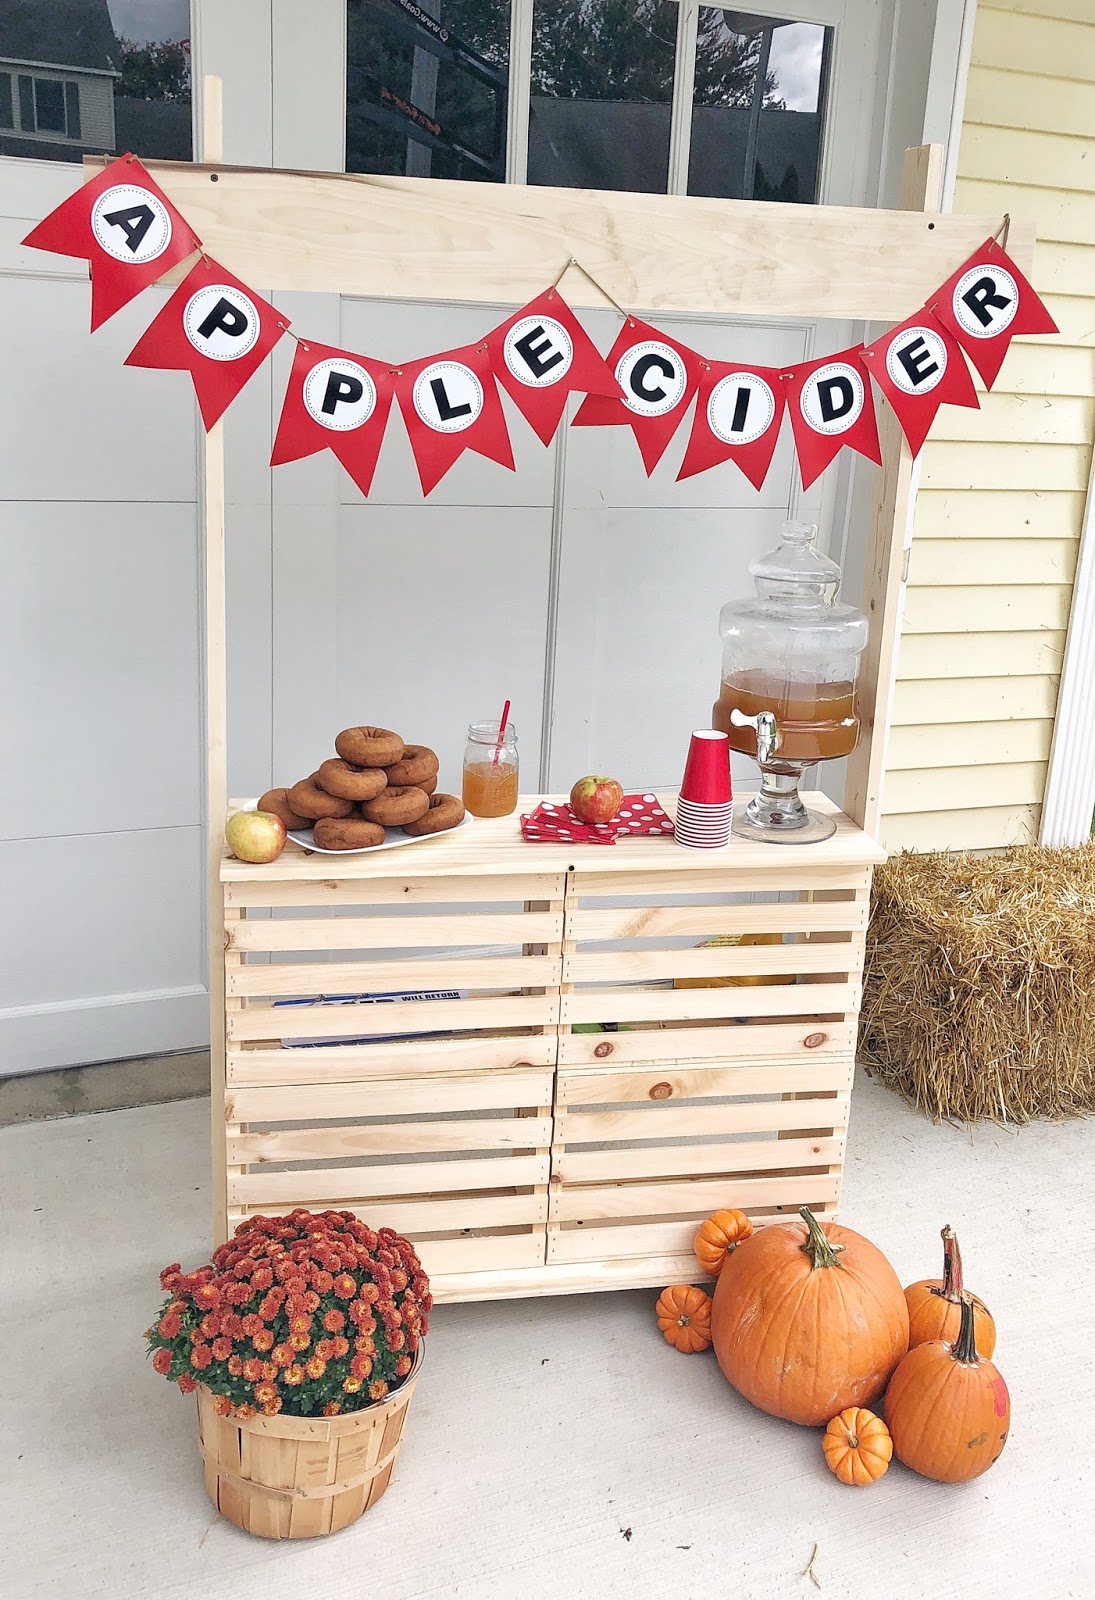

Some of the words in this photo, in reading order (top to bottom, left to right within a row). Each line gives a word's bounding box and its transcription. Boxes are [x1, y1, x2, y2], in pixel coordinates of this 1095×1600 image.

[103, 205, 564, 421] APPLE
[630, 277, 1011, 432] CIDER
[401, 994, 423, 1002] WILL
[425, 991, 460, 1000] RETURN
